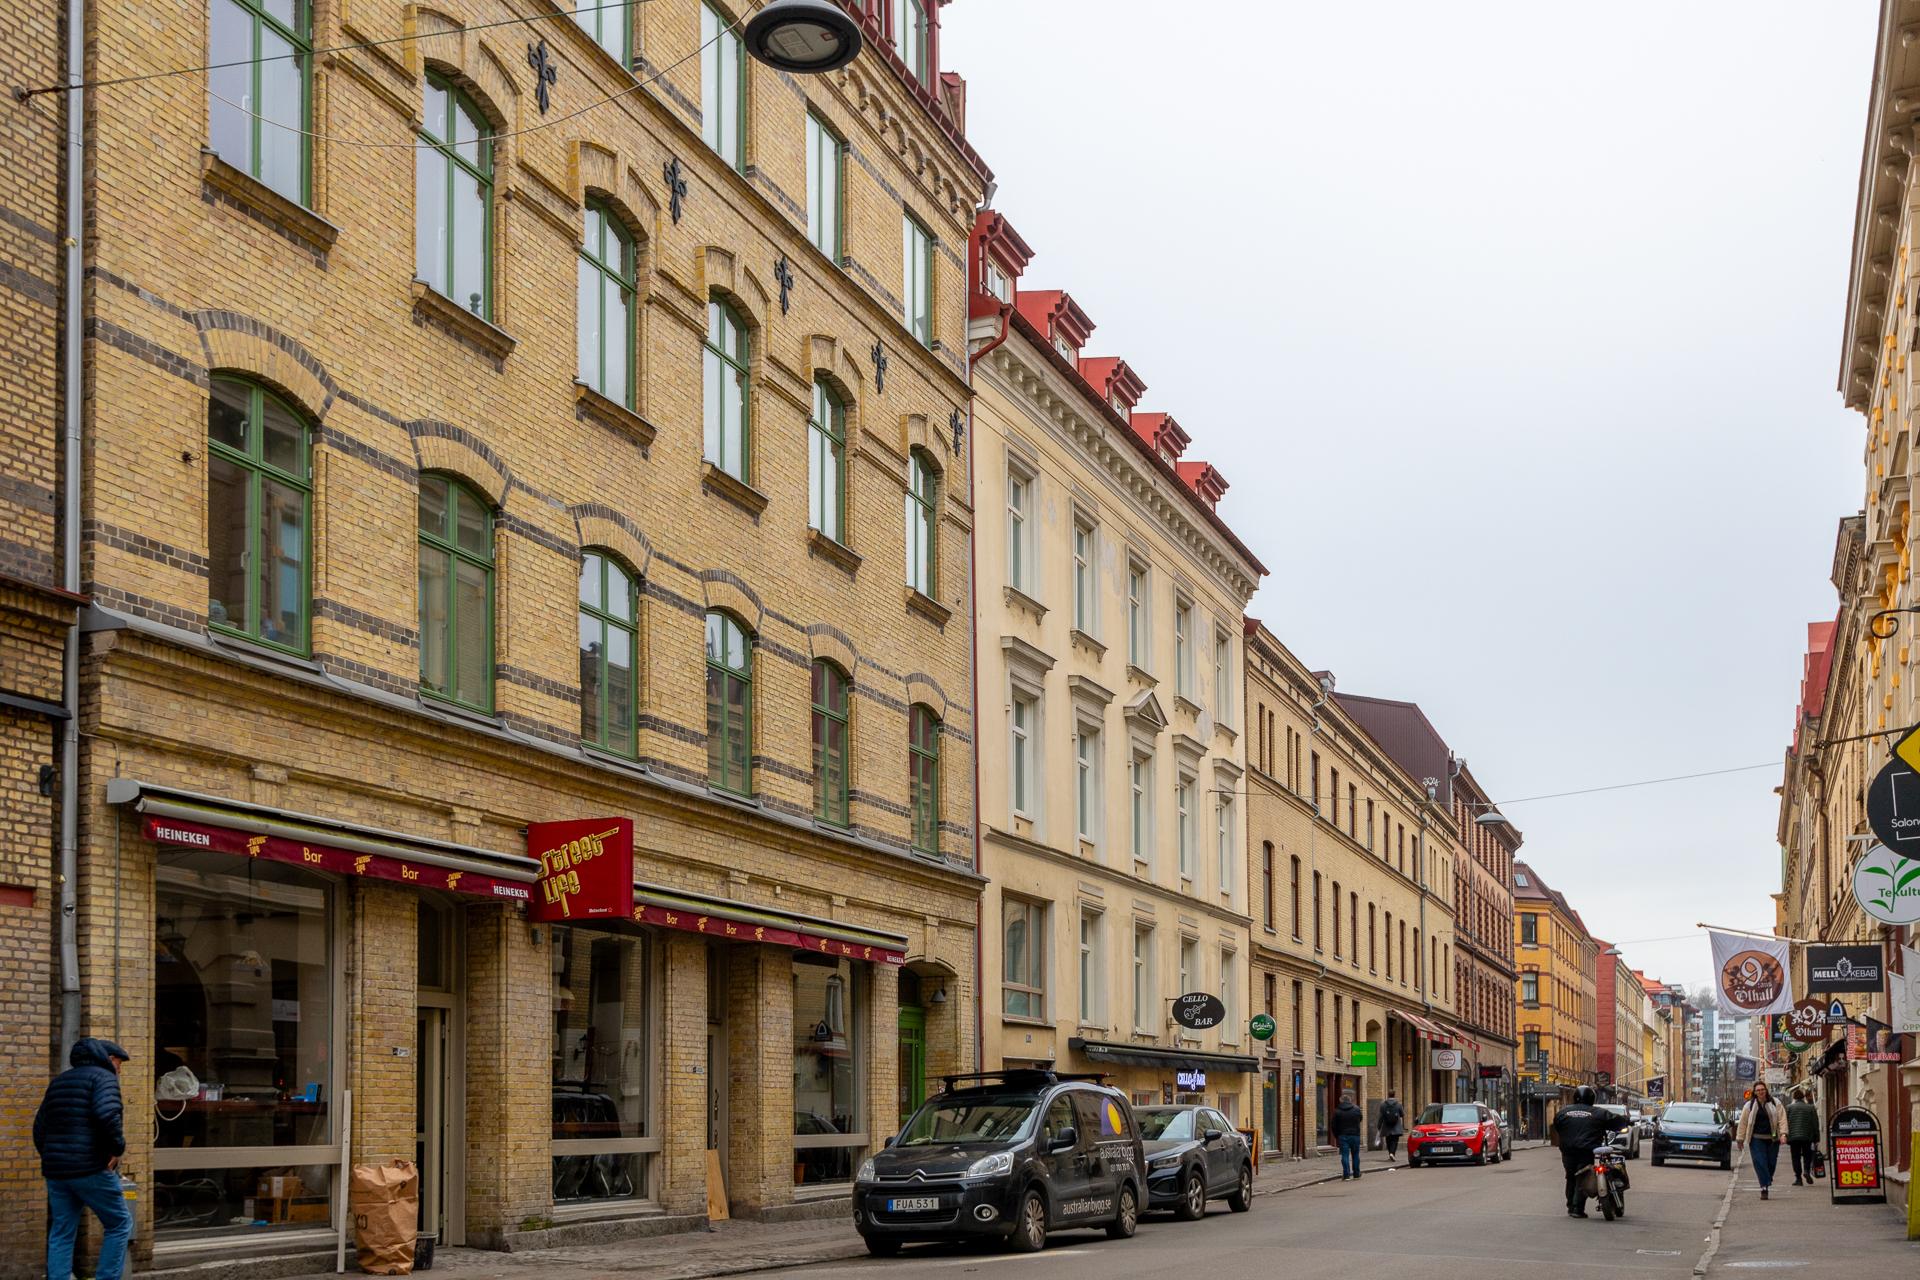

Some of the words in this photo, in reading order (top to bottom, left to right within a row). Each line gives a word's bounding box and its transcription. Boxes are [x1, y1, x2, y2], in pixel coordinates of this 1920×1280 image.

[1891, 817, 1920, 828] Salon
[156, 826, 210, 846] HEINEKEN
[303, 846, 323, 864] Bar
[402, 864, 420, 881] Bar
[493, 885, 530, 899] HEINEKEN
[666, 911, 679, 926] Bar
[726, 922, 738, 936] Bar
[1740, 956, 1763, 987] 9
[1814, 970, 1839, 978] MELLI
[1850, 969, 1876, 978] KEBAB
[1182, 995, 1209, 1003] CELLO
[1734, 986, 1774, 1003] Ölhall
[1194, 1017, 1214, 1026] BAR
[1802, 1005, 1817, 1026] 9
[1794, 1025, 1822, 1037] Ölhall
[1836, 1146, 1875, 1154] STANDARD
[1841, 1170, 1874, 1185] 89:-
[896, 1200, 914, 1210] FUA
[916, 1199, 935, 1209] 531
